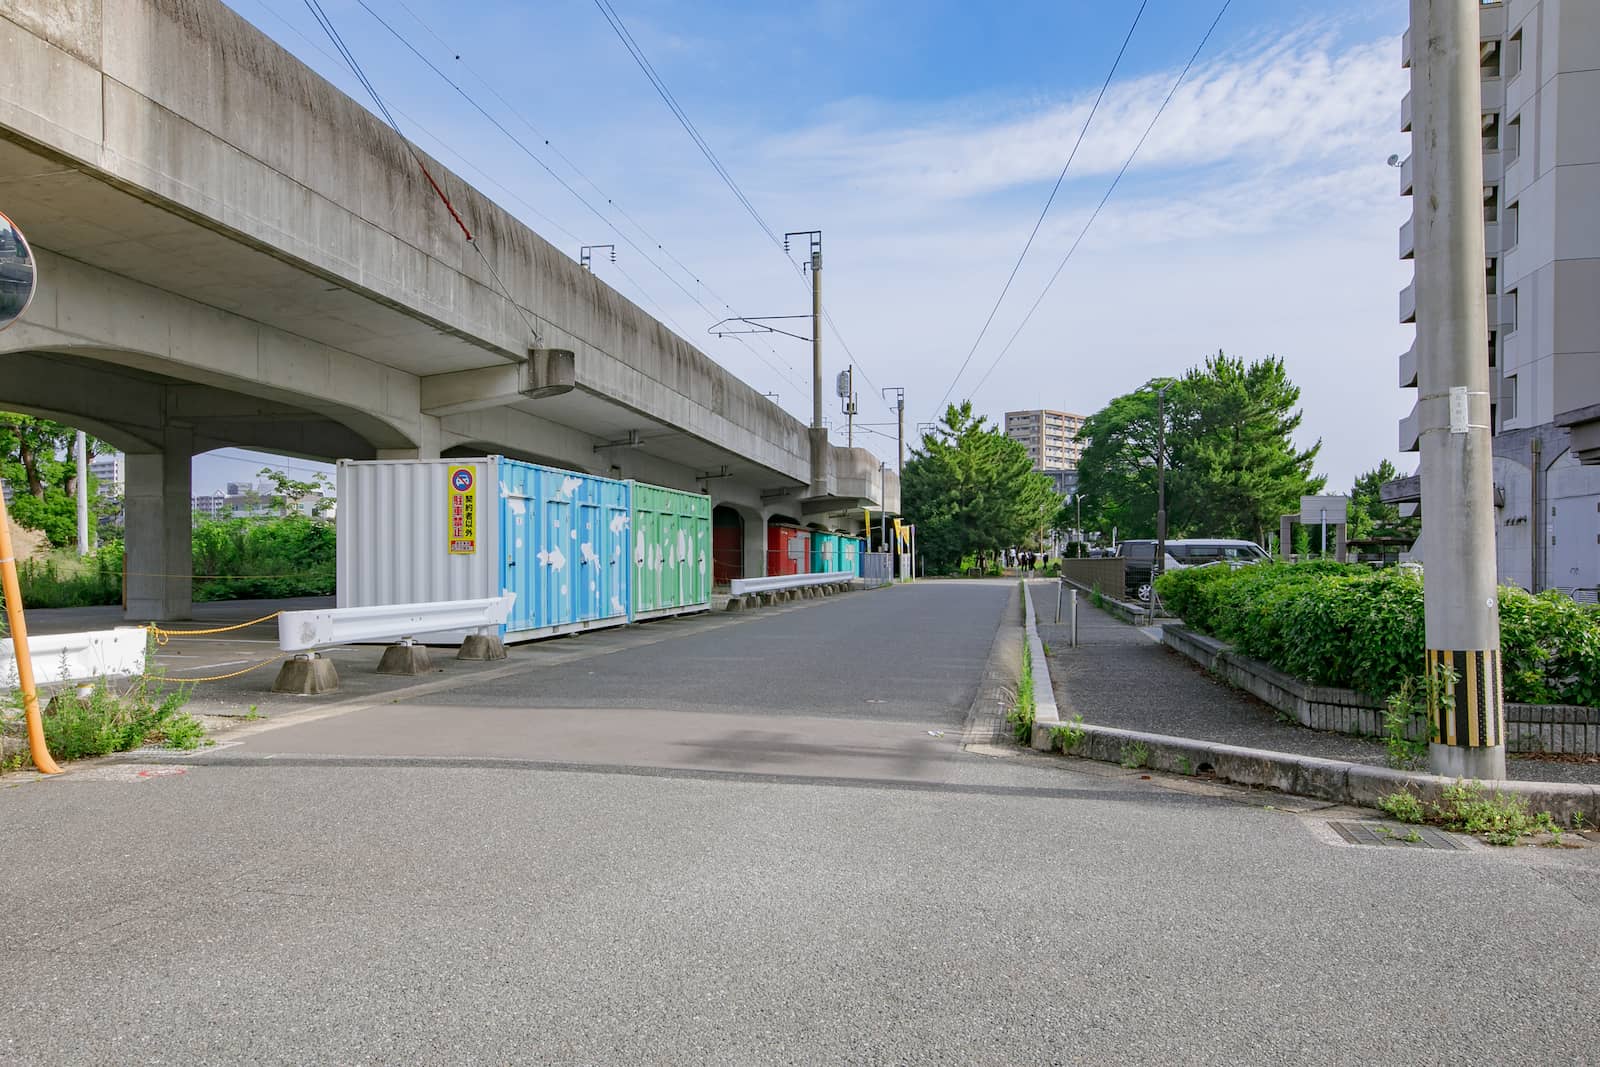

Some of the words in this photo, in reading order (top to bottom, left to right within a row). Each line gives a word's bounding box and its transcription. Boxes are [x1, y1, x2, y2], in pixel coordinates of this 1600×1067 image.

[453, 495, 463, 537] 駐車禁止
[465, 495, 473, 537] 契約者以外
